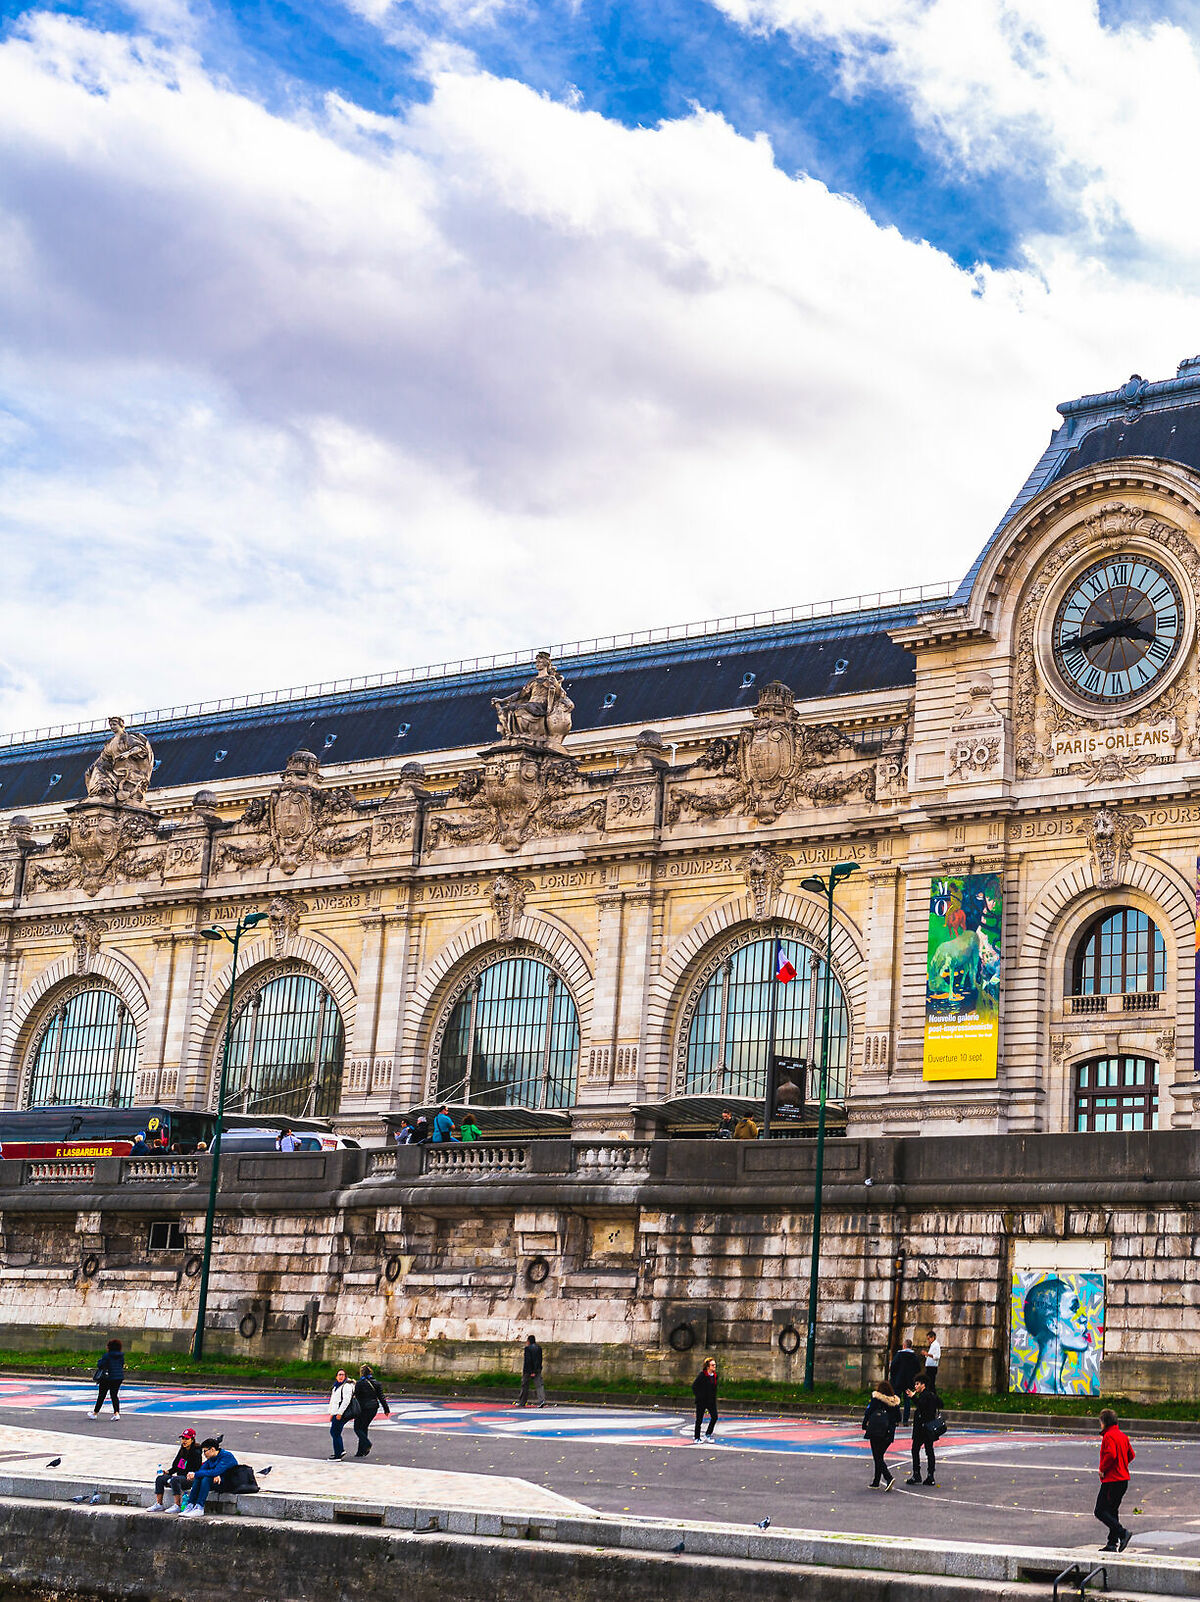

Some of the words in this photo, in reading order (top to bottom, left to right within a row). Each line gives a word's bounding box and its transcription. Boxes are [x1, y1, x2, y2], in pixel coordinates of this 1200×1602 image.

[1111, 564, 1128, 587] XII
[1086, 574, 1105, 598] XI
[1151, 586, 1170, 605] II
[1067, 599, 1087, 617] X
[1157, 614, 1177, 630] III
[1136, 664, 1150, 683] V
[1111, 673, 1124, 694] VI
[1056, 730, 1170, 755] PARIS-ORLEANS
[957, 746, 990, 768] PO
[1145, 807, 1200, 826] TOURS
[1024, 819, 1073, 838] BLOIS
[796, 846, 866, 865] AURILLAC
[669, 858, 732, 875] QUIMPER
[540, 872, 596, 889] LORIENT
[428, 883, 480, 900] VANNES
[311, 895, 360, 911] ANGERS
[214, 905, 259, 920] NANTES
[21, 923, 68, 938] BORDEAUX
[928, 1054, 958, 1063] Ouverture
[56, 1148, 62, 1157] F.
[63, 1147, 113, 1157] LASBAREILLES
